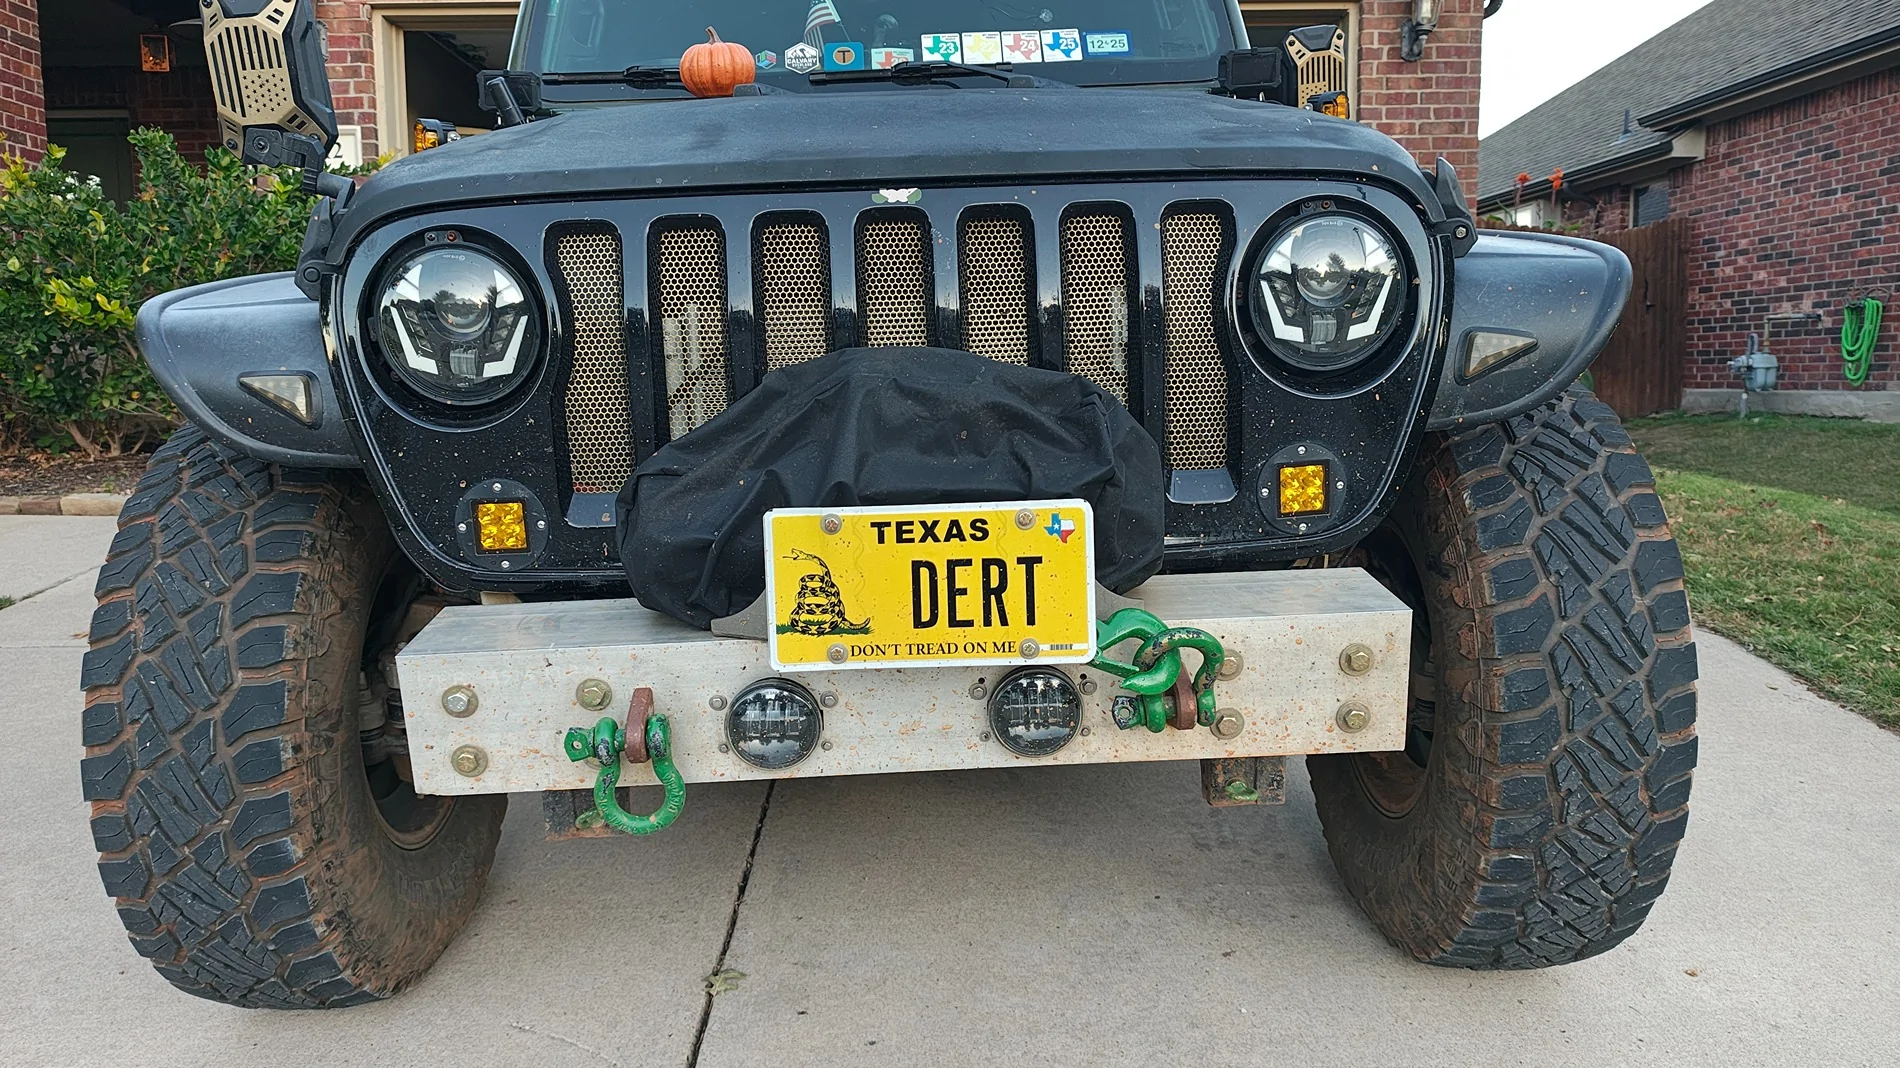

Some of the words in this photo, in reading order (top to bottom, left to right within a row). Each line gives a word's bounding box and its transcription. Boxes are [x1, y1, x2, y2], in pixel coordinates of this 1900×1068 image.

[939, 42, 955, 54] 23
[1020, 40, 1035, 52] 24
[1060, 38, 1076, 50] 25
[837, 50, 851, 63] T
[870, 518, 990, 545] TEXAS
[911, 556, 1043, 630] DERT
[850, 643, 902, 658] DON'T
[905, 642, 959, 656] TREAD
[963, 641, 988, 654] ON
[992, 640, 1017, 653] ME
